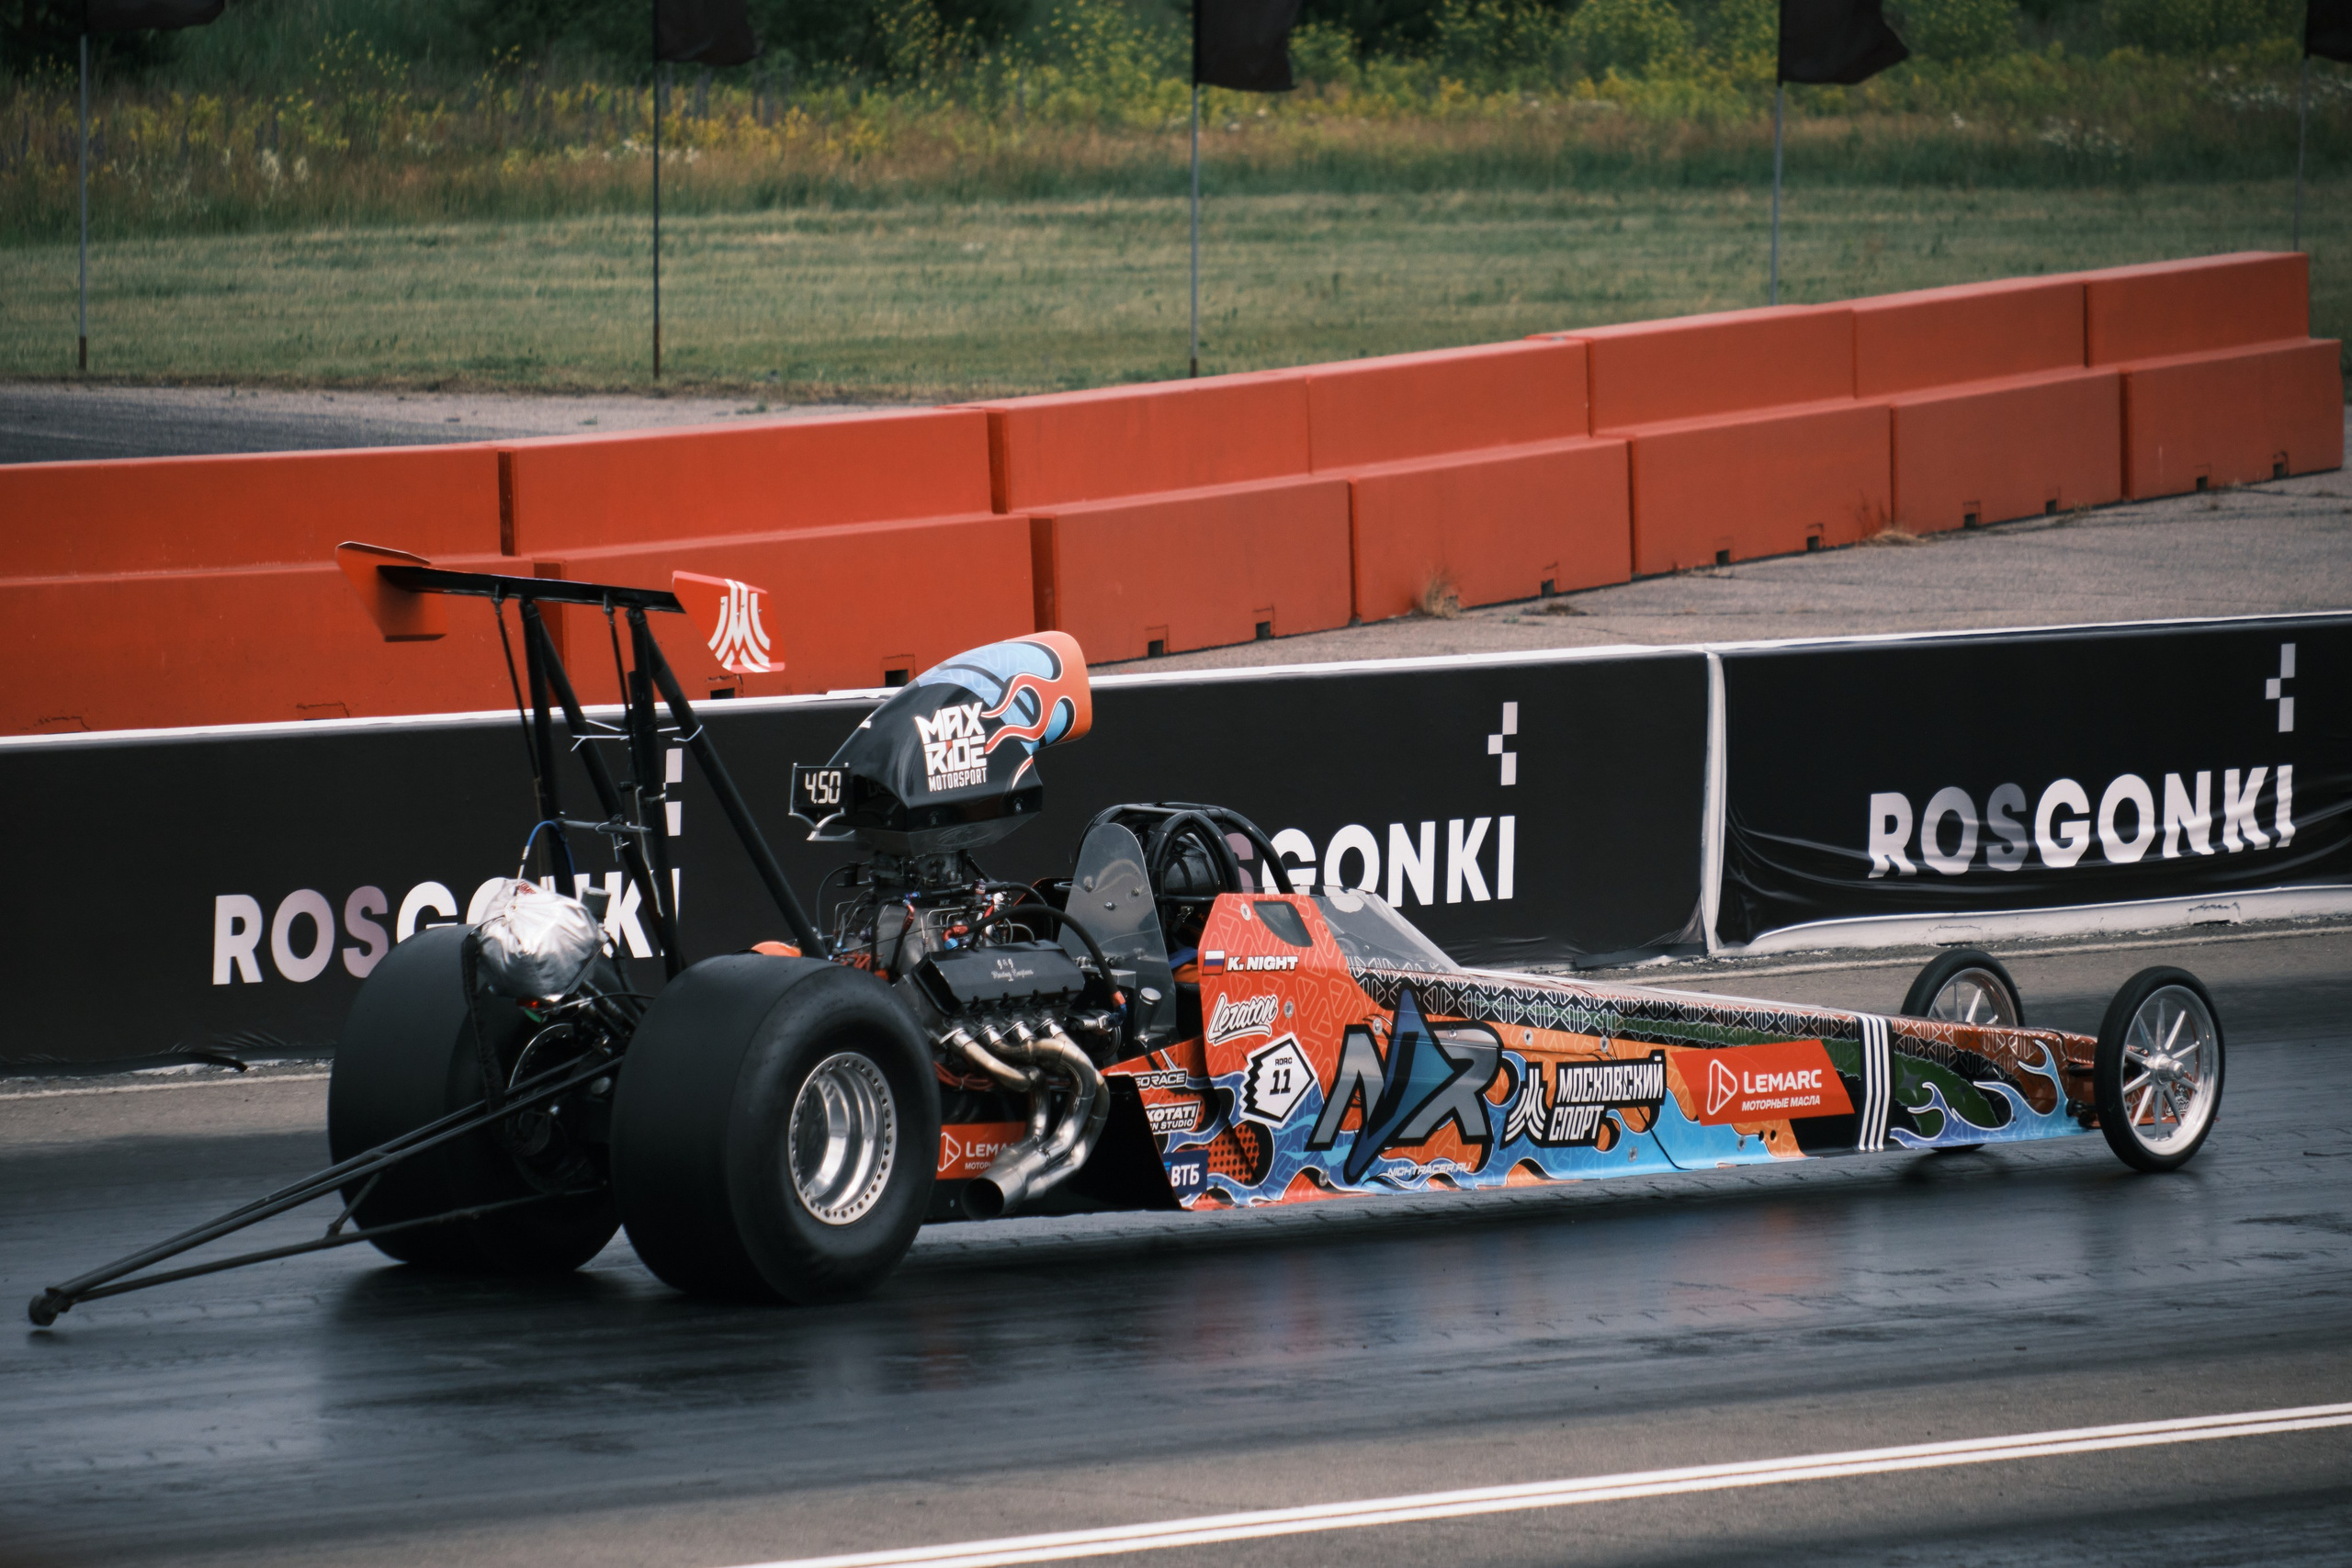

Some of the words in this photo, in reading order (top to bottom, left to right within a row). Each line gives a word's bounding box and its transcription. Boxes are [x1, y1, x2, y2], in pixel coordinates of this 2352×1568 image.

[914, 702, 986, 745] MAX
[923, 734, 988, 775] RIDE
[804, 771, 842, 804] 4.50
[928, 768, 988, 792] MOTORSPORT
[1868, 764, 2296, 878] ROSGONKI
[1227, 956, 1244, 971] K.
[1246, 956, 1298, 971] NIGHT
[1270, 1068, 1292, 1096] 11
[1557, 1055, 1664, 1103] МОСКОВСКИЙ
[1743, 1069, 1822, 1094] LEMARC
[1742, 1098, 1789, 1111] МОТОРНЫЕ
[1790, 1095, 1820, 1108] МАСЛА
[1160, 1118, 1194, 1130] STUDIO
[1549, 1105, 1604, 1142] СПОРТ
[1171, 1163, 1200, 1187] ВТБ
[1387, 1162, 1472, 1177] NIGHTRACER.RU
